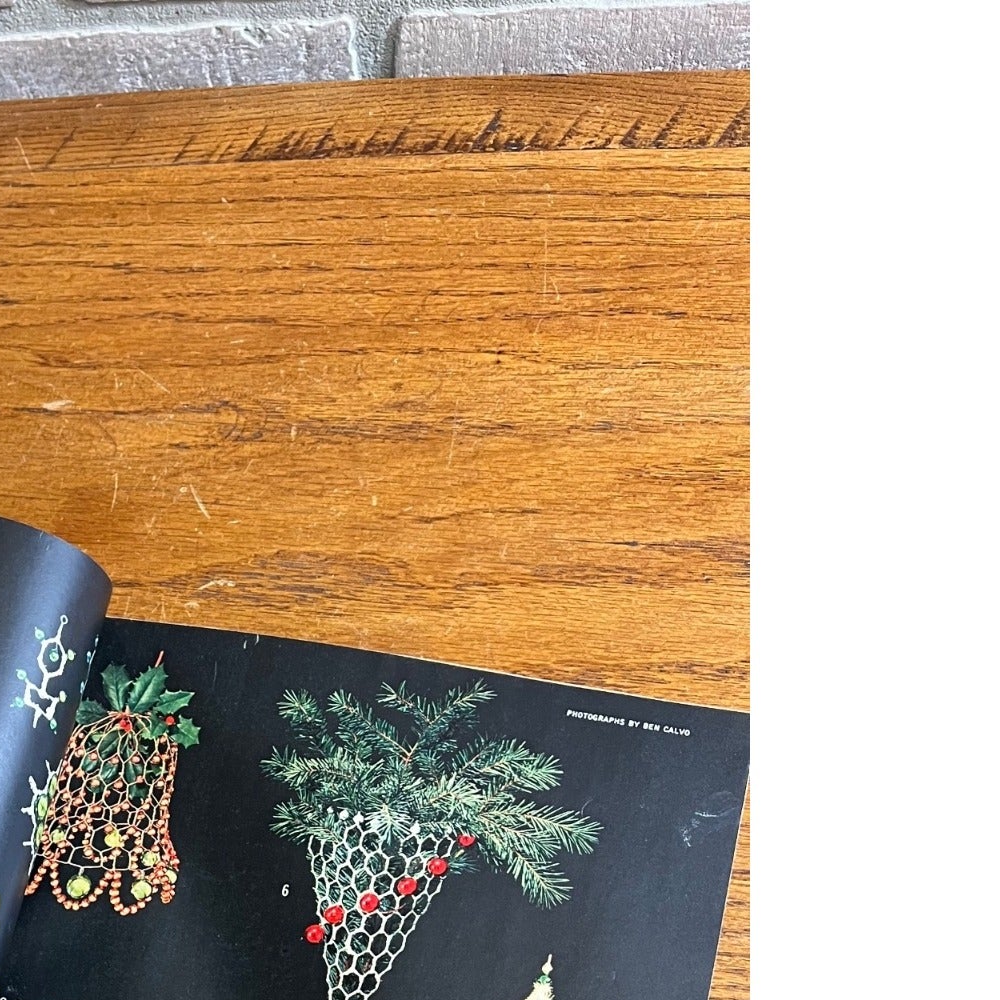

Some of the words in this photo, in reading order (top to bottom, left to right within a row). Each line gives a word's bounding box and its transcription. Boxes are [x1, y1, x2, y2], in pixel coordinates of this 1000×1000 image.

[566, 709, 625, 726] PHOTOGRAPHS
[628, 720, 640, 728] BY
[643, 722, 660, 732] BEN
[663, 726, 691, 737] CALVO
[281, 883, 290, 897] 6
